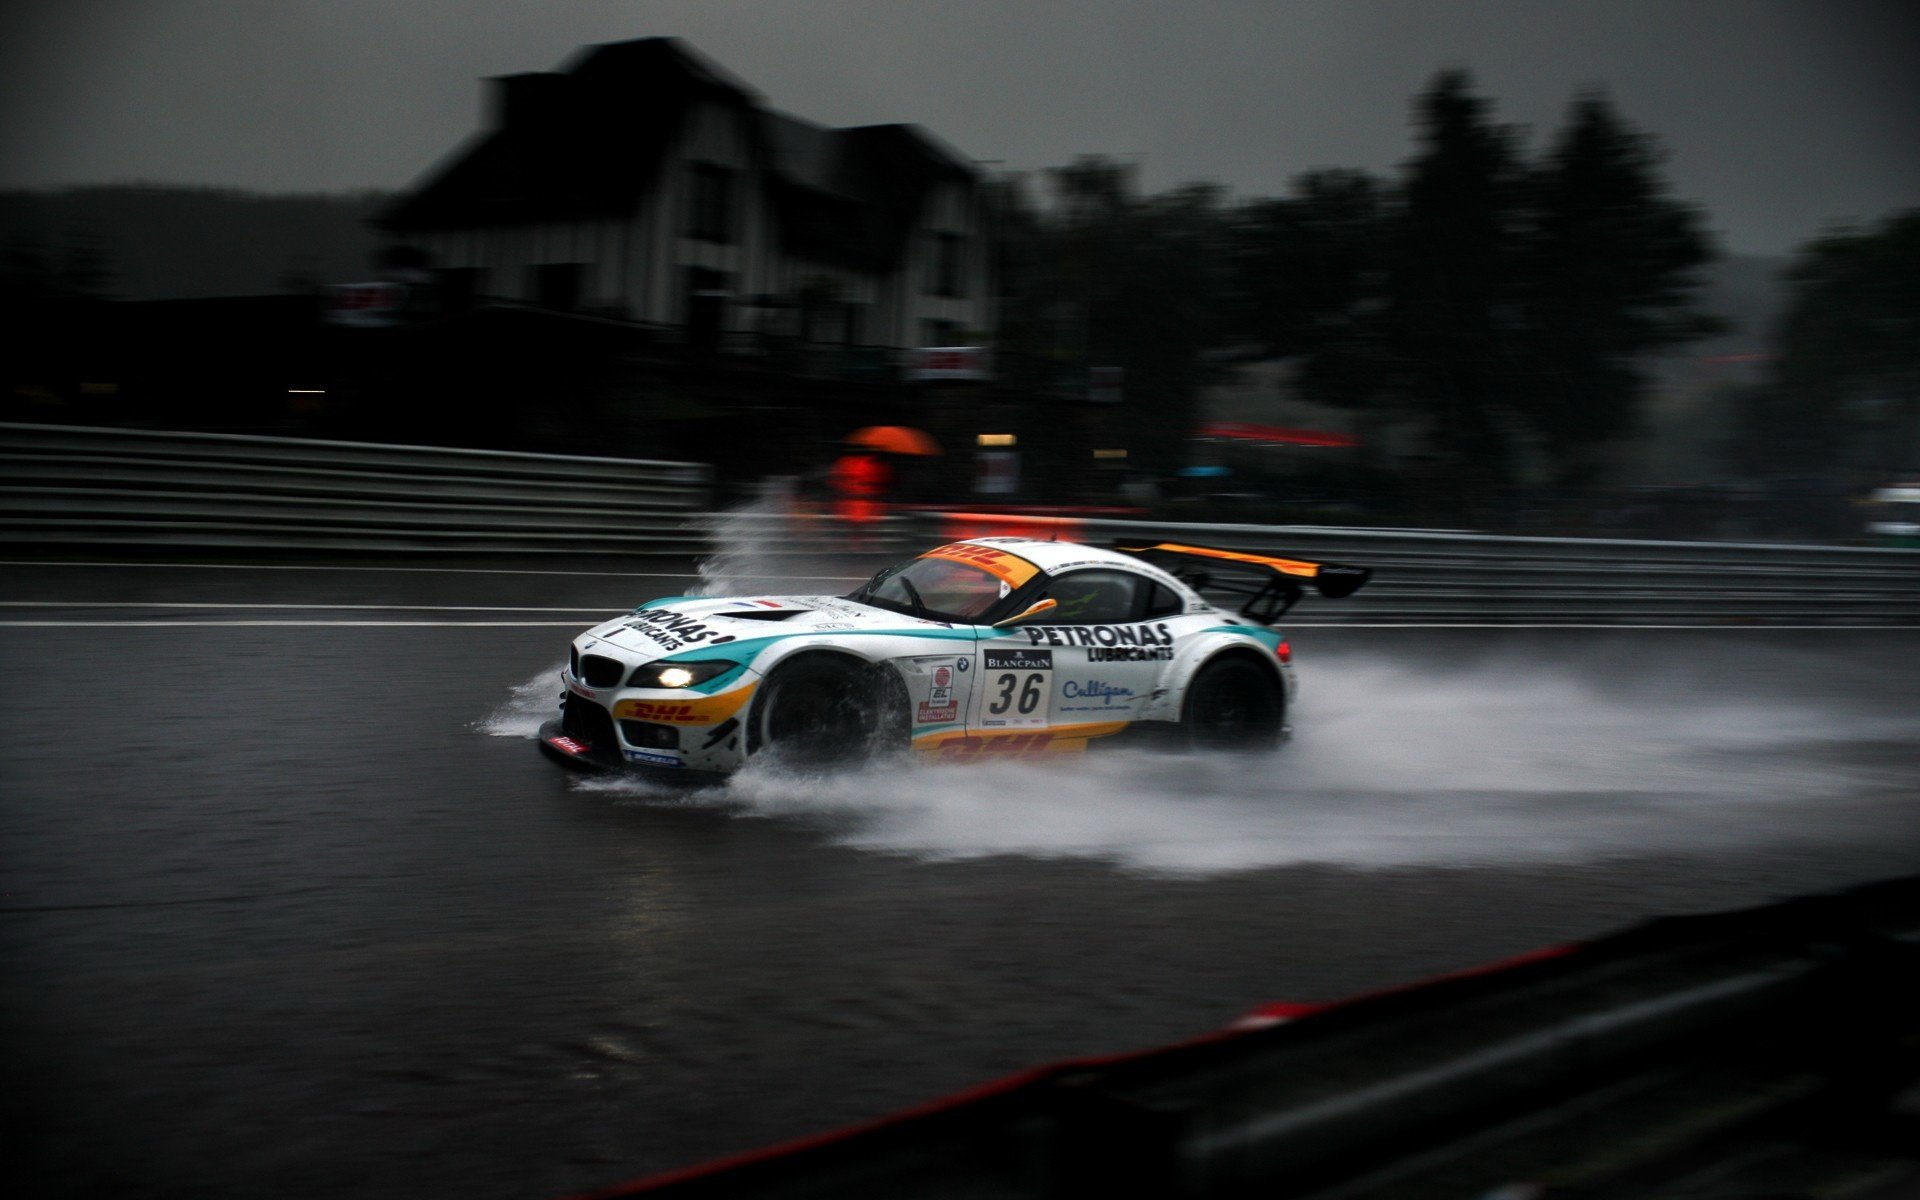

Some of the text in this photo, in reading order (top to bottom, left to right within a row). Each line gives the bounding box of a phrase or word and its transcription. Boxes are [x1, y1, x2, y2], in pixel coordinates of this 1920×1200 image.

[930, 544, 1008, 566] DHL
[627, 609, 719, 643] RONAS
[1024, 623, 1173, 647] PETRONAS
[988, 658, 1050, 668] BLANCPAIN
[1087, 646, 1174, 662] LUBRICANTS
[933, 689, 947, 698] EL
[989, 673, 1044, 714] 36
[1063, 680, 1134, 705] Culligan
[628, 702, 697, 722] DHL
[553, 736, 583, 753] TOTAL
[938, 733, 1055, 765] DHL
